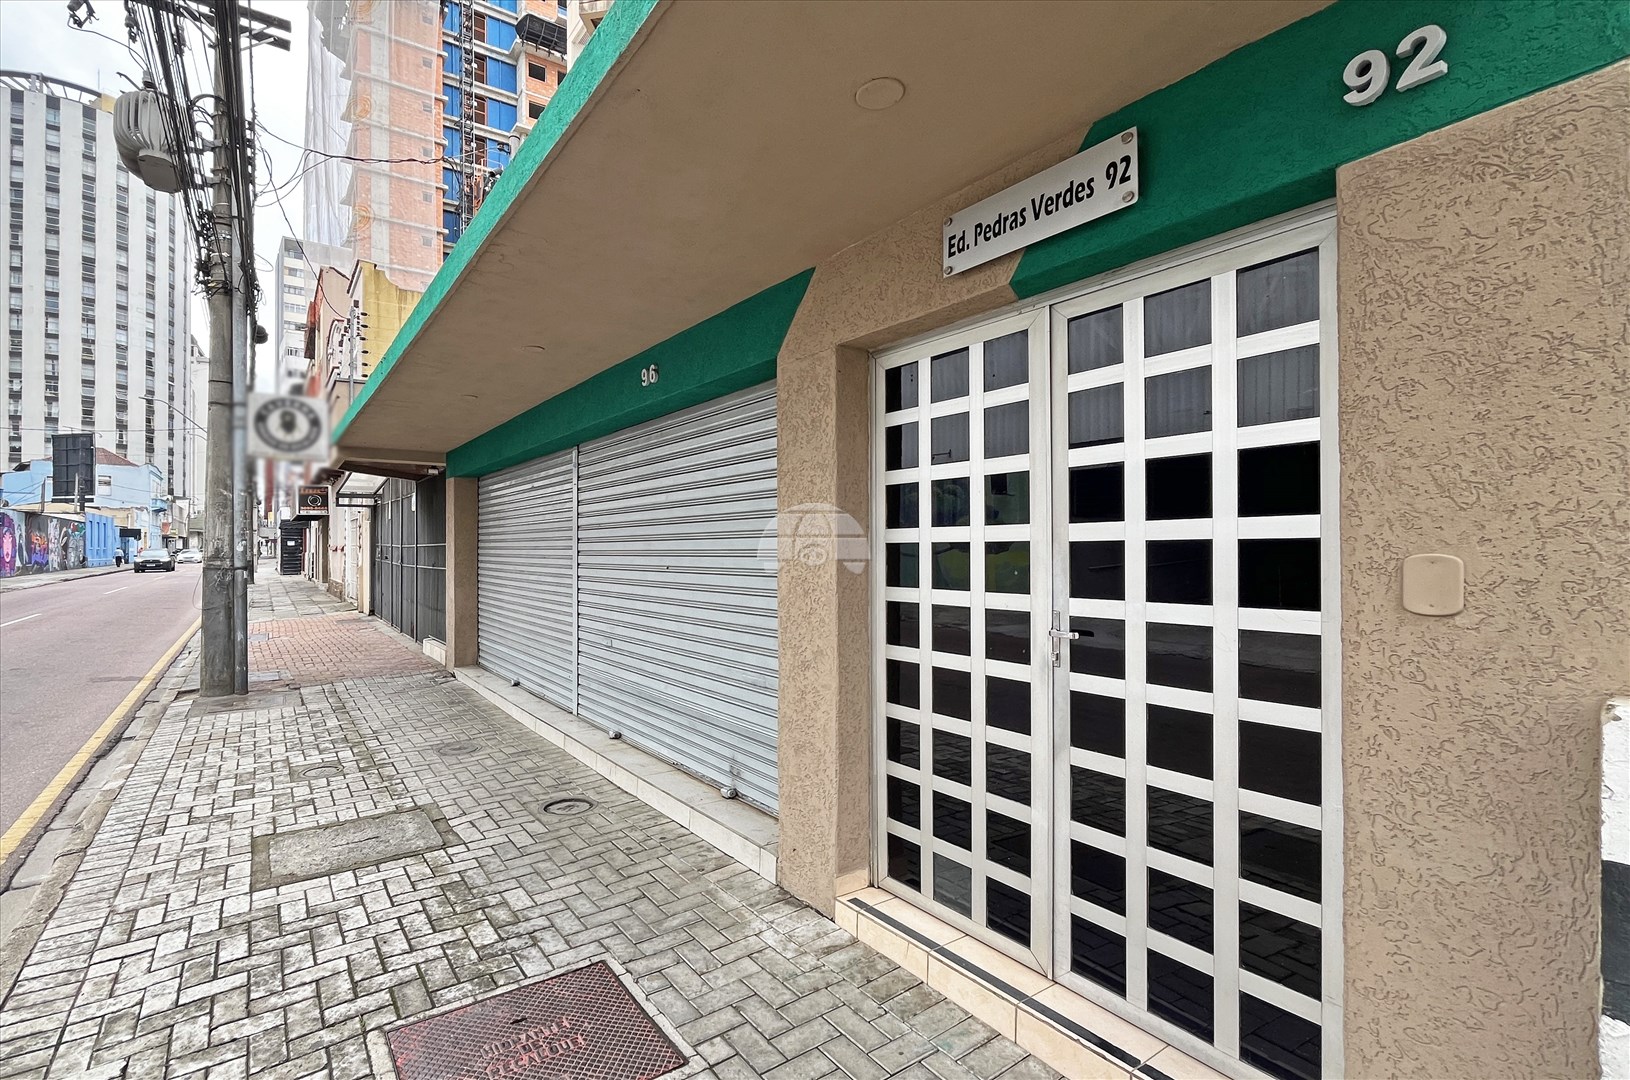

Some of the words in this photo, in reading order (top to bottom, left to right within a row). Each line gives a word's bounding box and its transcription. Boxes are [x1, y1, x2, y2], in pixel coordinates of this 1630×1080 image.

[1343, 24, 1448, 106] 92
[947, 230, 970, 258] Ed.
[974, 207, 1026, 247] Pedras
[1031, 177, 1095, 221] Verdes
[1105, 155, 1132, 190] 92
[641, 364, 659, 387] 96
[480, 1016, 571, 1059] HIDRANTE
